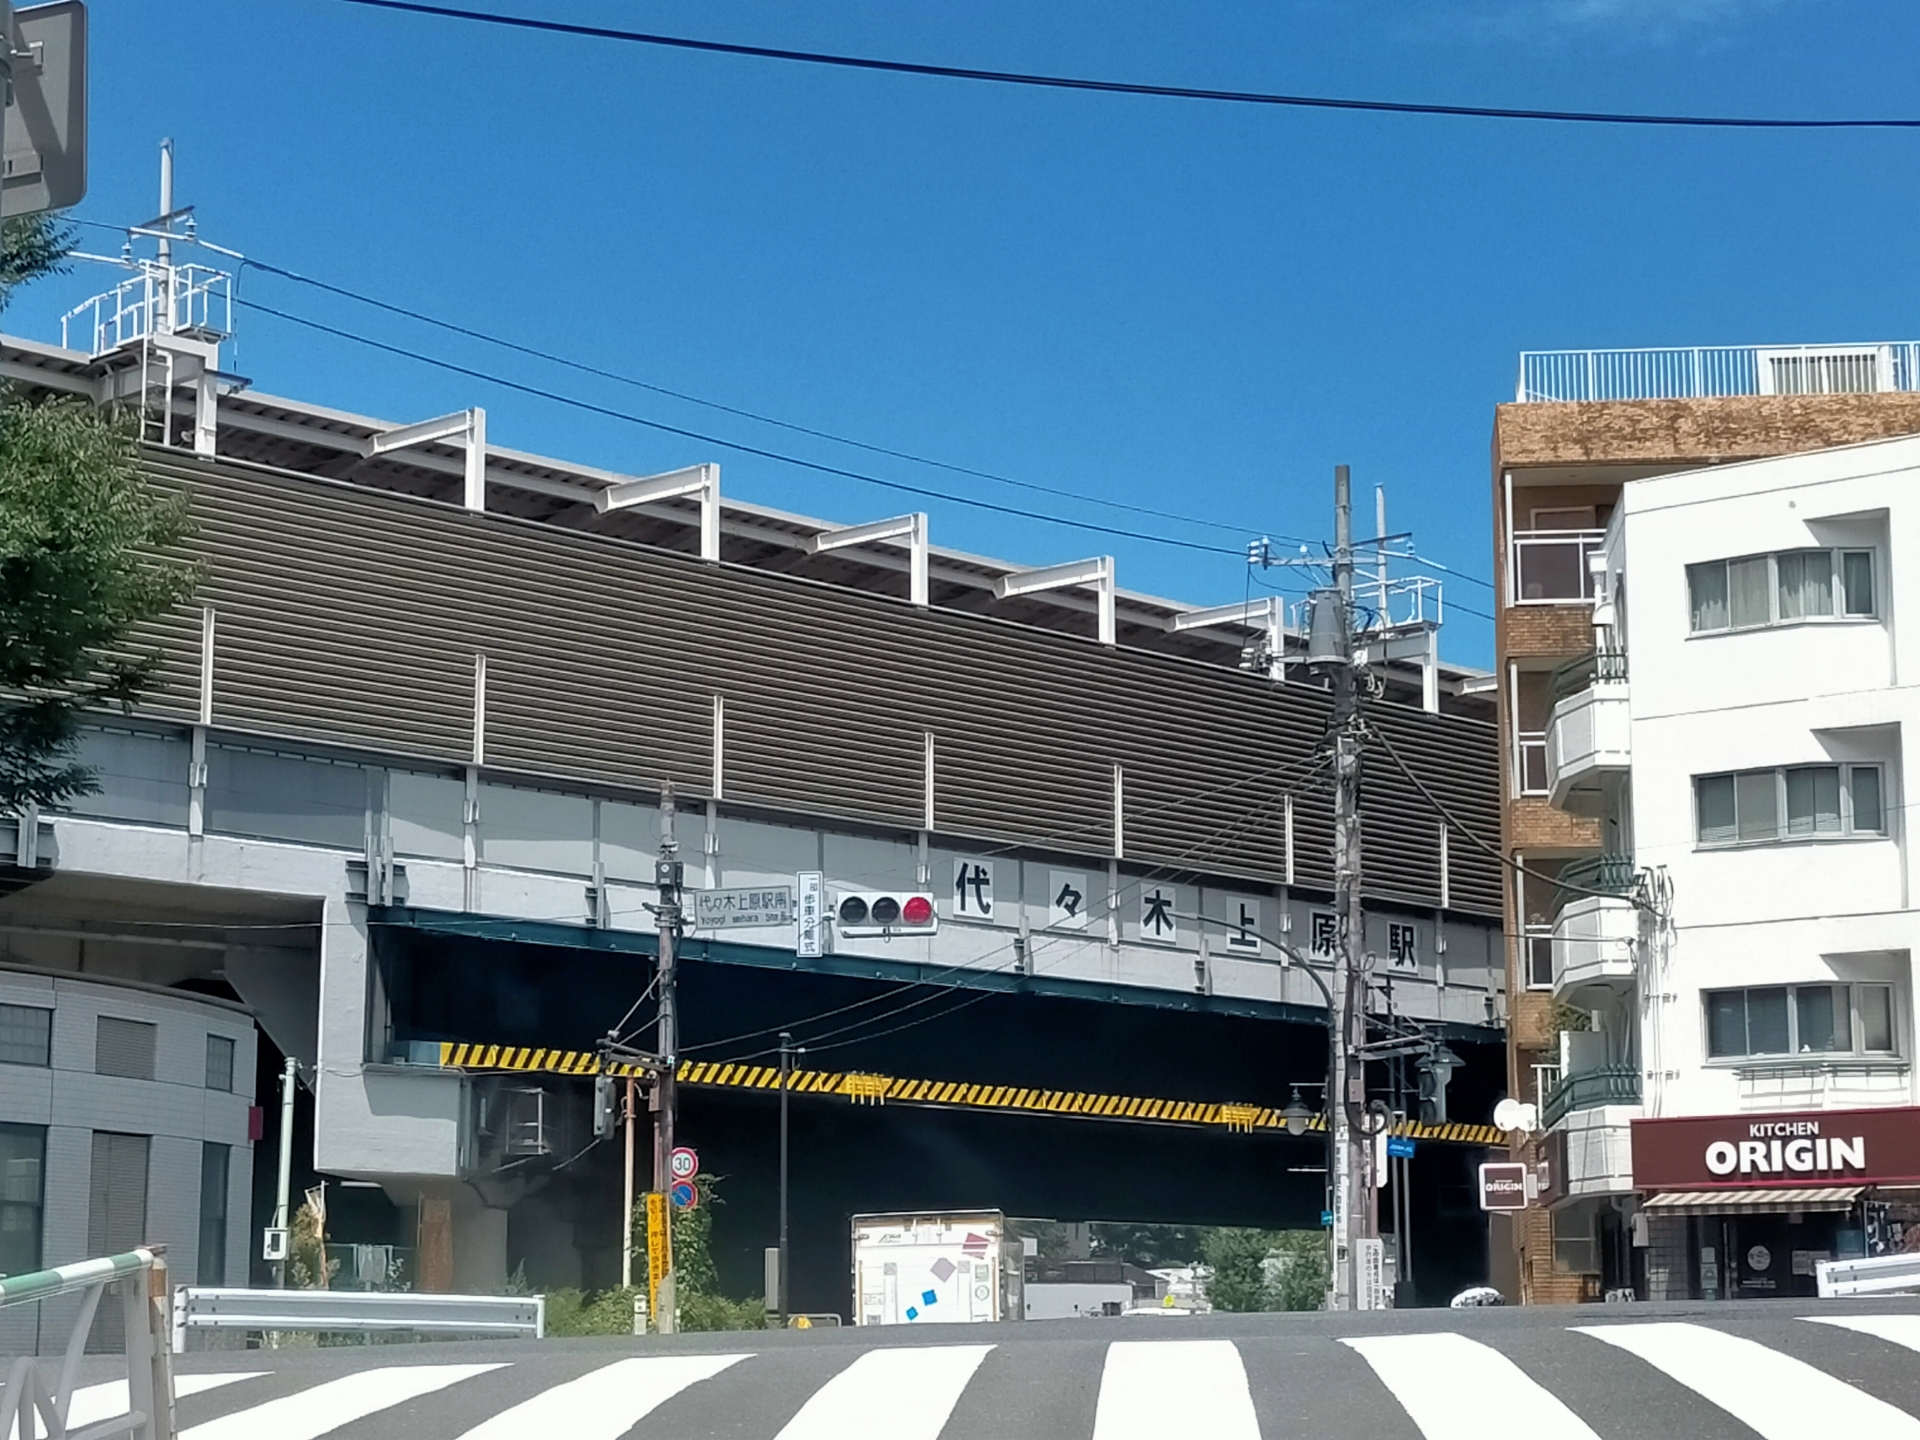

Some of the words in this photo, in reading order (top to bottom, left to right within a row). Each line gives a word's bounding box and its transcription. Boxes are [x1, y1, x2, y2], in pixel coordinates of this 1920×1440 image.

[699, 892, 787, 912] 代々木上原駅南
[956, 862, 1415, 967] 代々木上原駅
[1750, 1121, 1819, 1138] KITCHEN
[674, 1157, 691, 1171] 30
[1705, 1136, 1866, 1175] ORIGIN
[1485, 1183, 1523, 1192] ORIGIN
